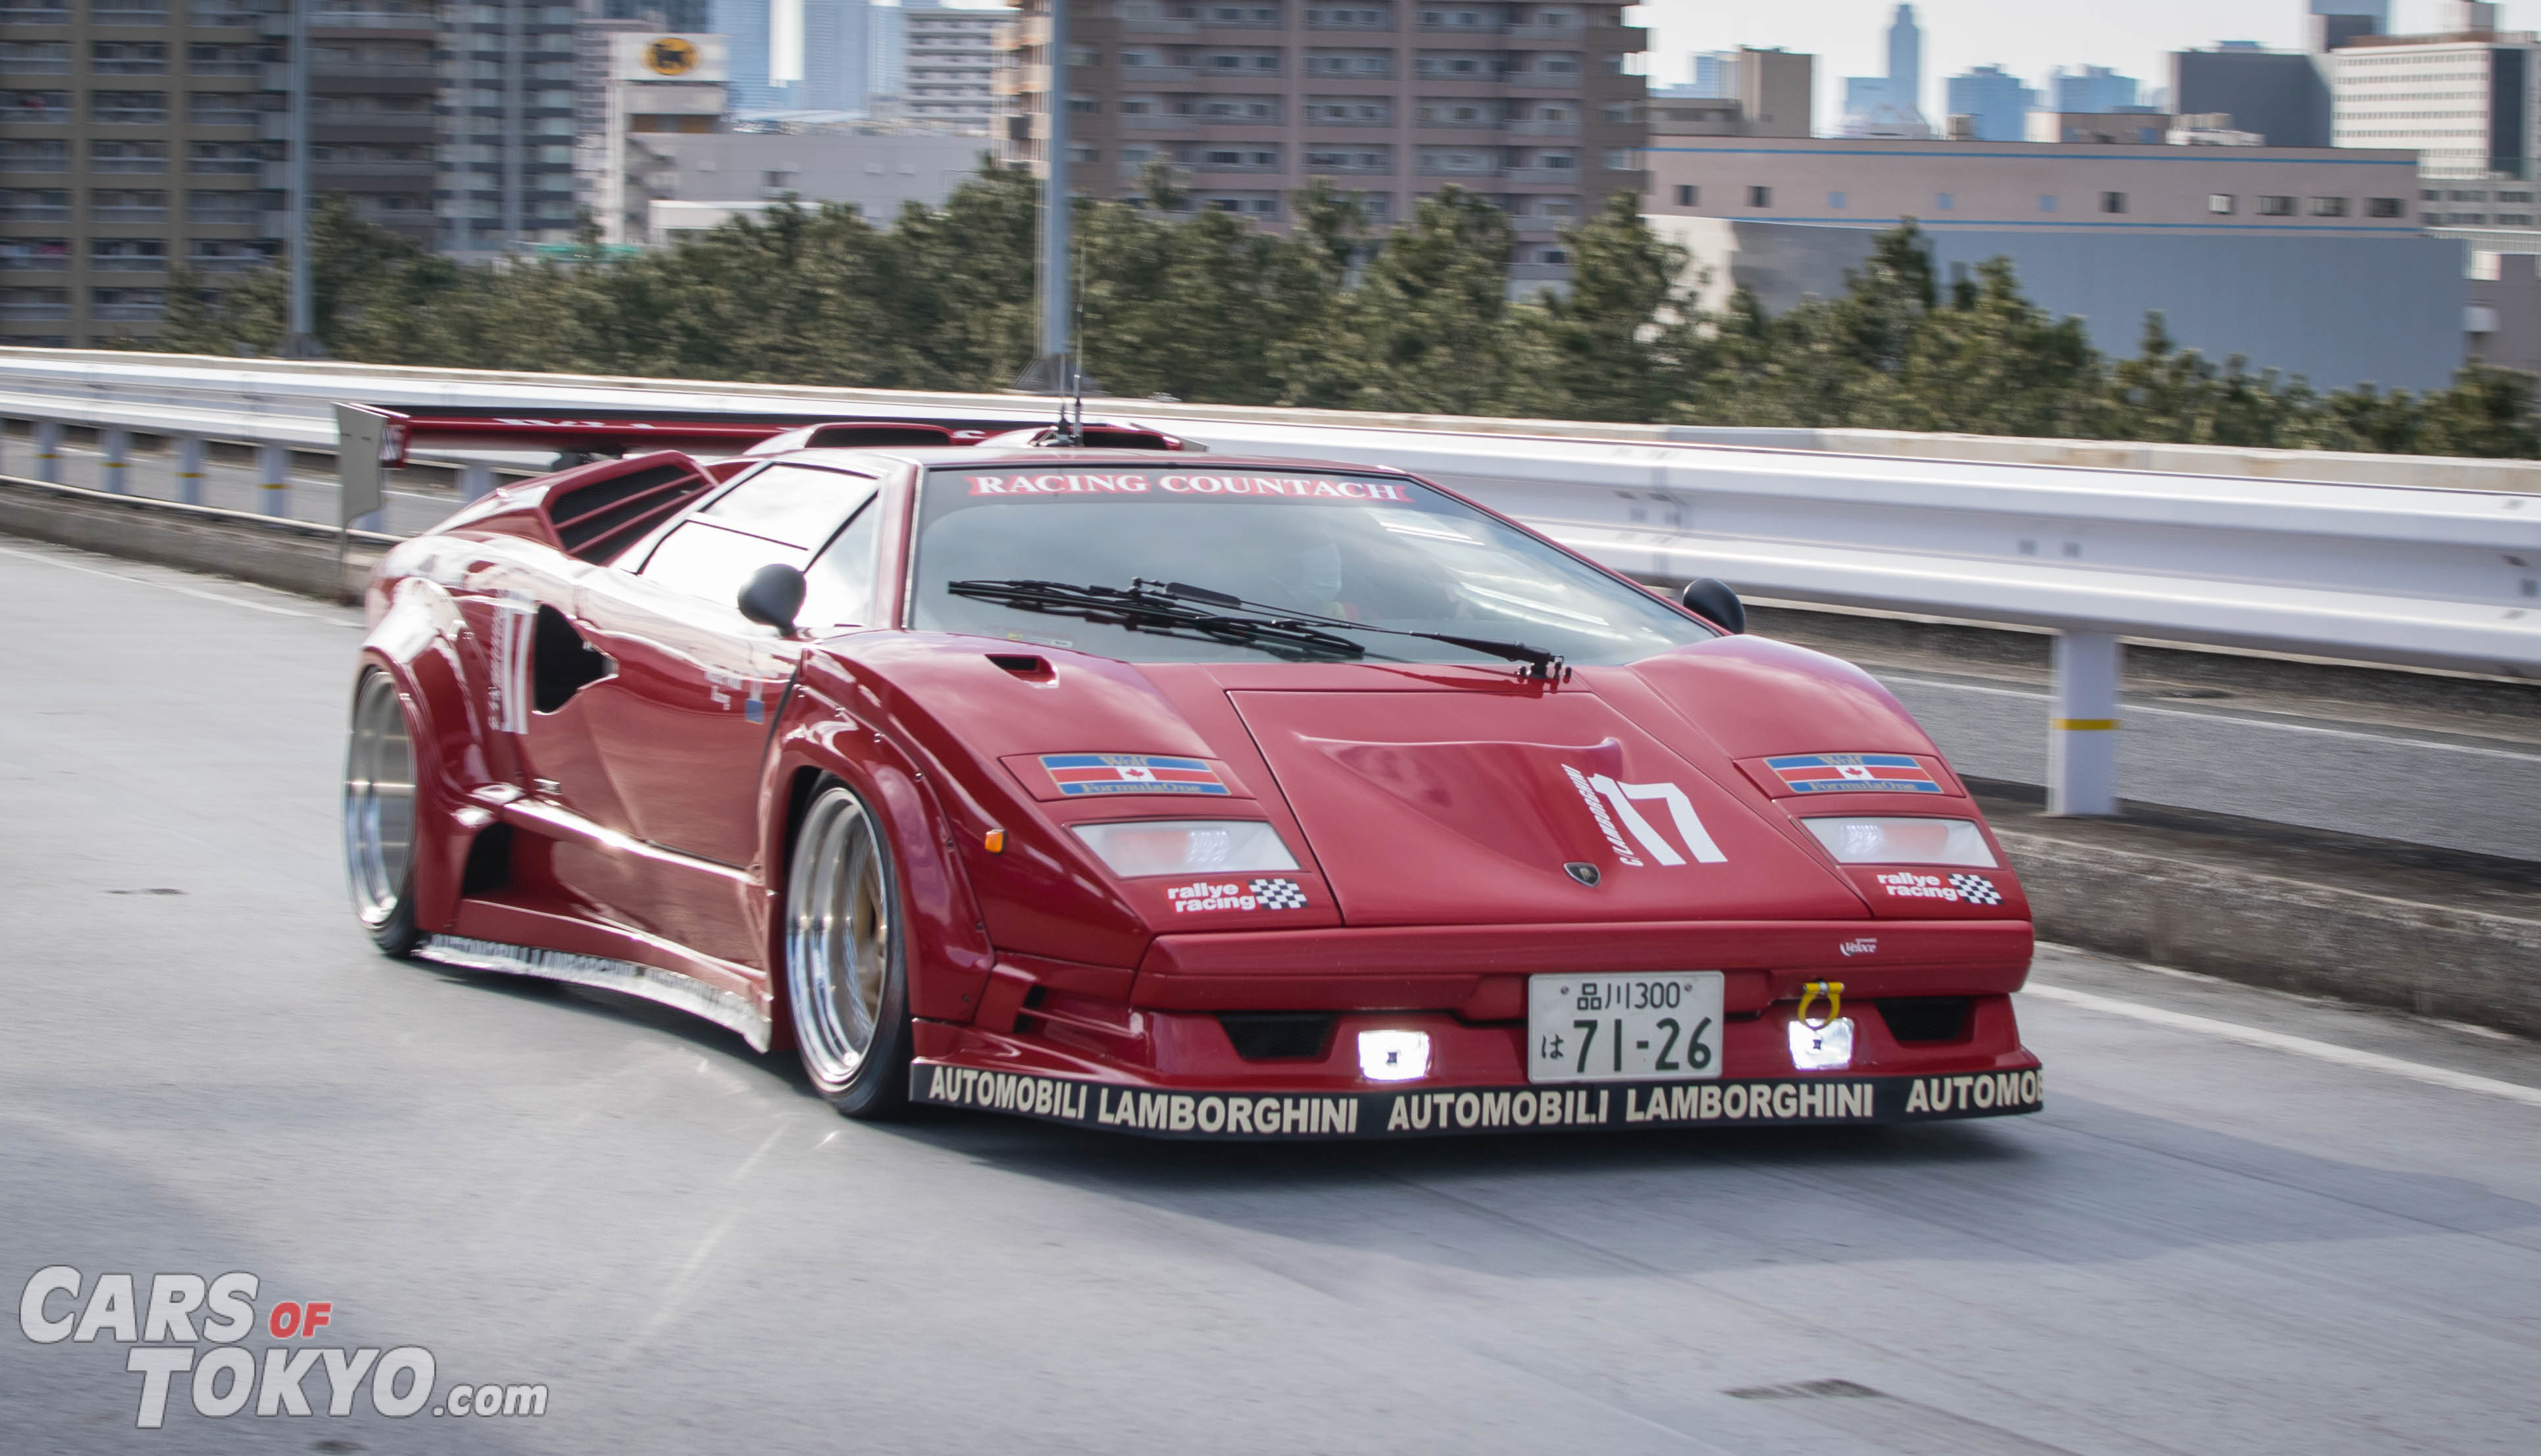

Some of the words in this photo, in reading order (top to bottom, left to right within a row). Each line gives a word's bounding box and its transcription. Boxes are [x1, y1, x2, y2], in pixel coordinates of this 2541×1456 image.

[976, 474, 1148, 493] RACING
[1159, 474, 1405, 500] COUNTACH
[1098, 755, 1147, 766] Wolf
[1818, 755, 1864, 765] Wolf
[1586, 772, 1728, 866] 17
[1877, 872, 1941, 888] rallye
[1167, 882, 1240, 900] rallye
[1886, 884, 1959, 901] racing
[1174, 893, 1257, 913] racing
[1542, 1034, 1564, 1059] は
[1573, 1017, 1713, 1073] 71-26
[928, 1066, 1088, 1119] AUTOMOBILI
[1097, 1087, 1359, 1134] LAMBORGHINI
[1387, 1089, 1609, 1132] AUTOMOBILI
[1625, 1083, 1874, 1122] LAMBORGHINI
